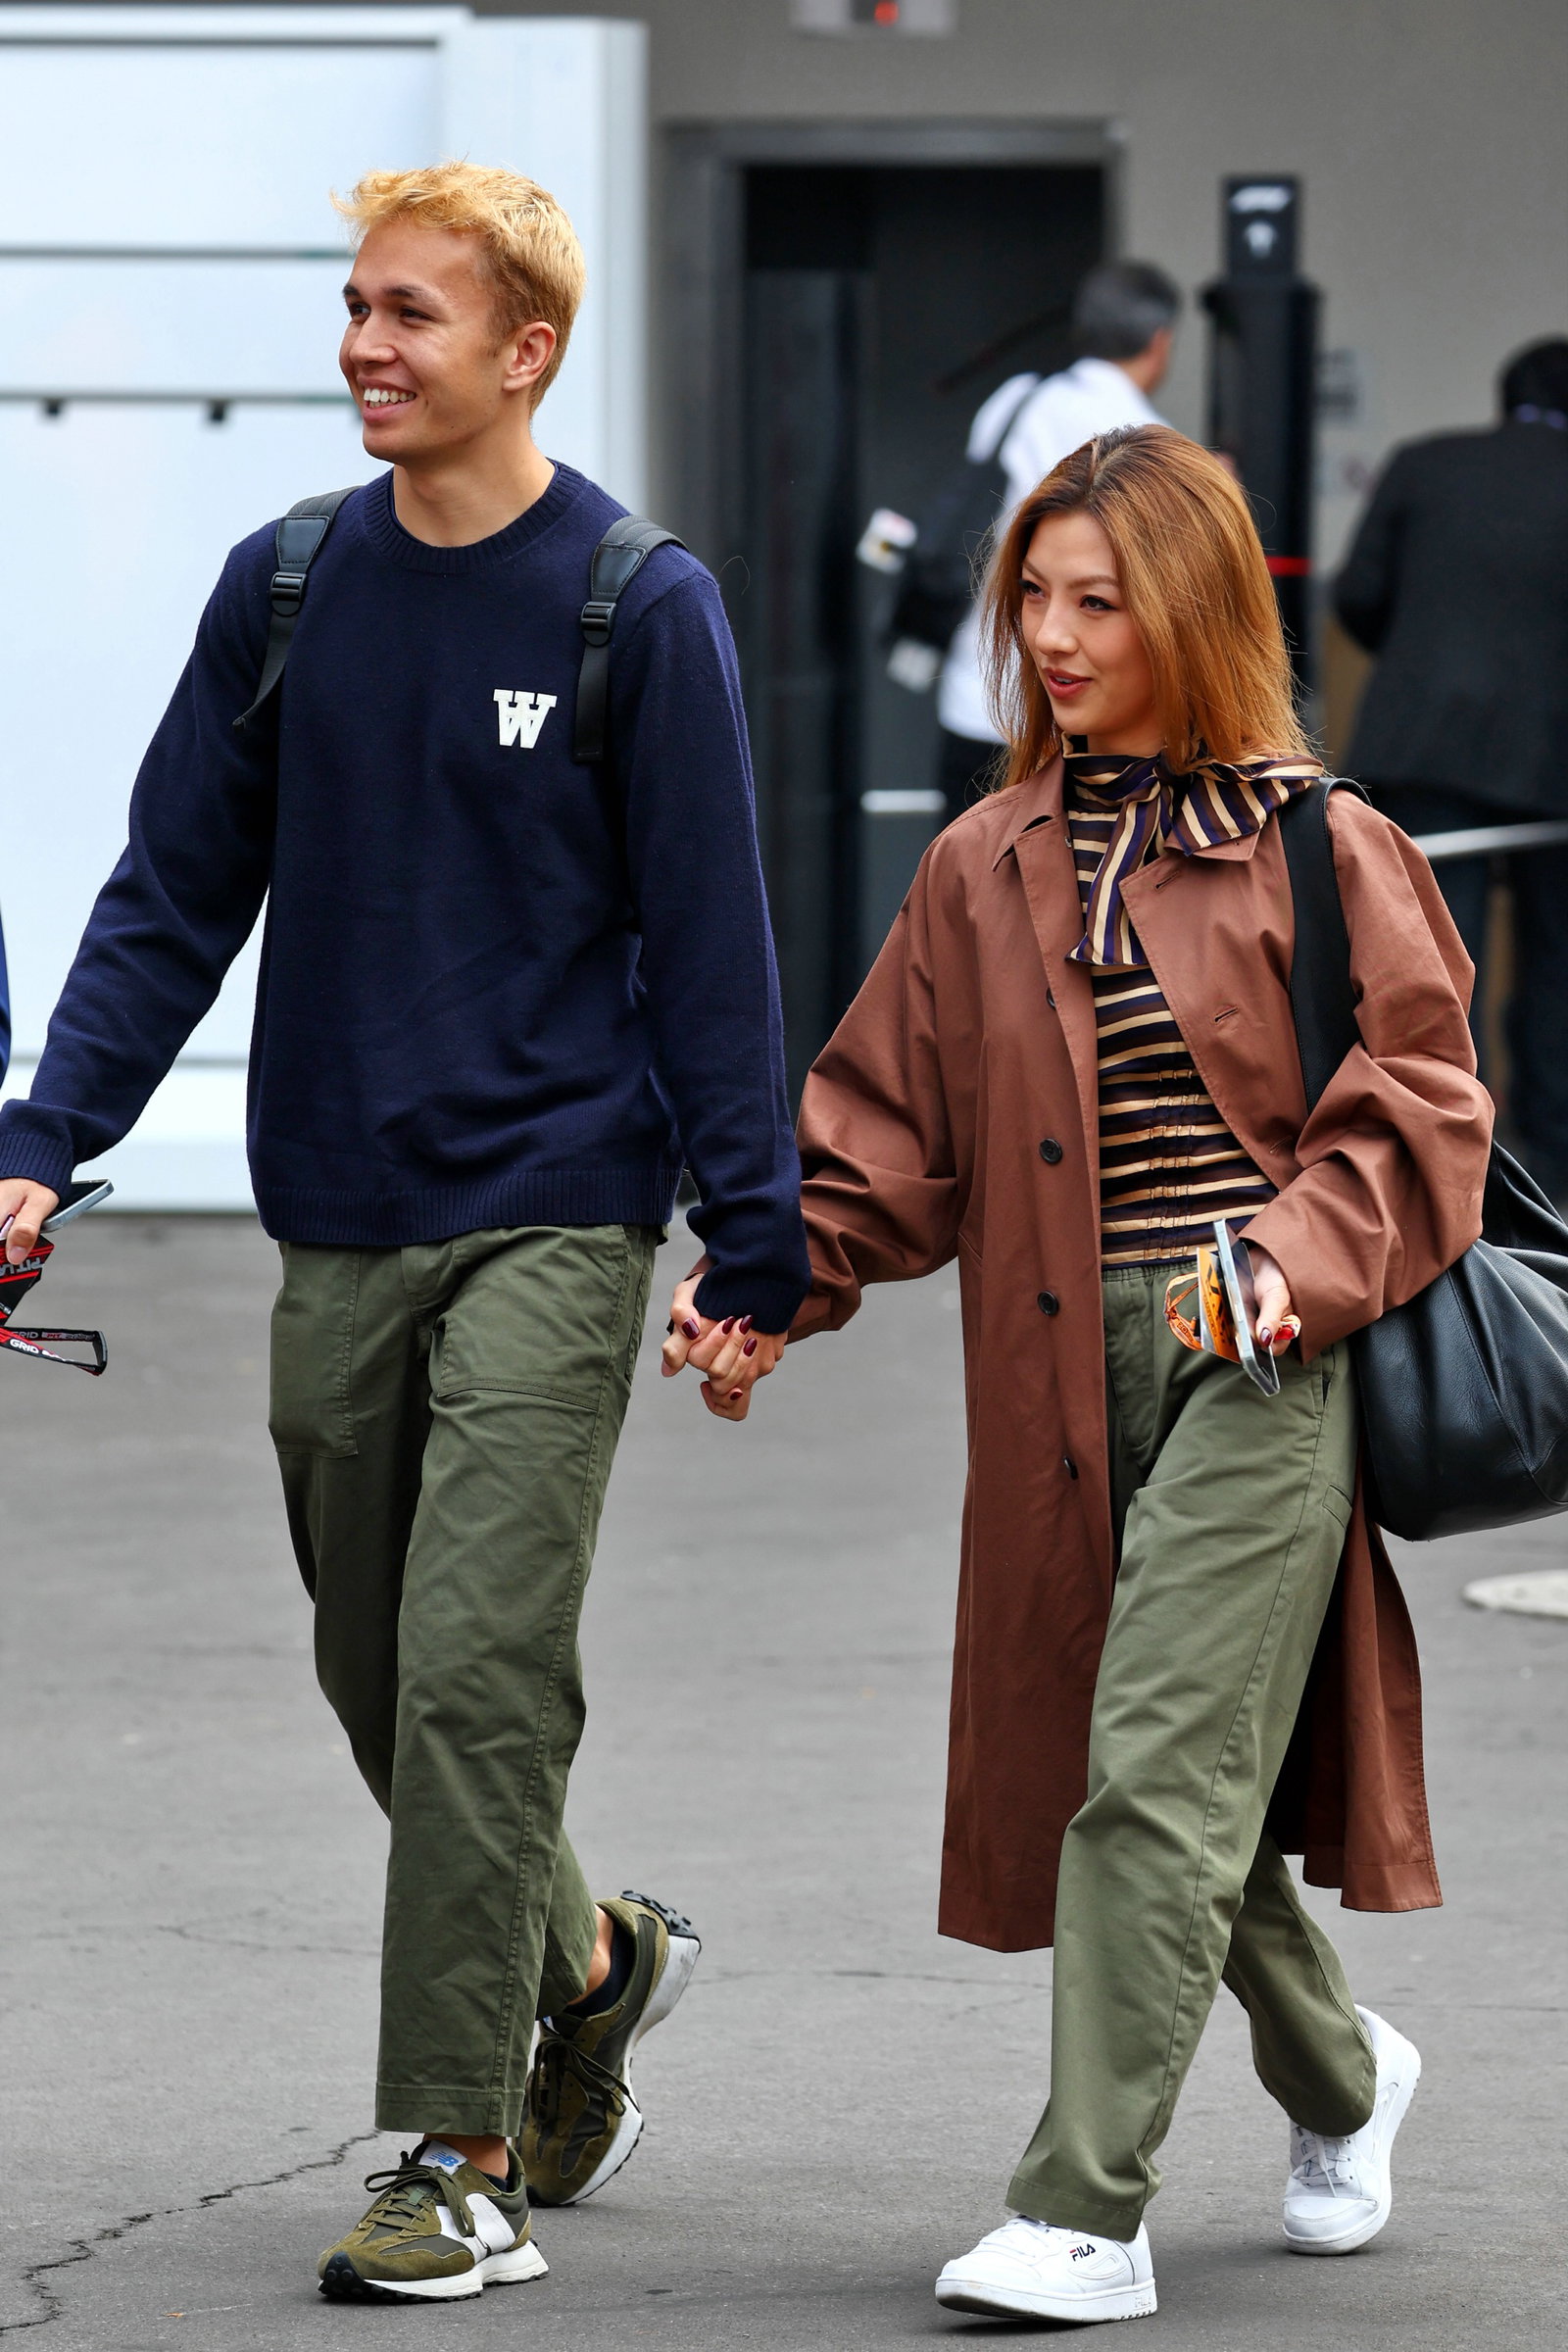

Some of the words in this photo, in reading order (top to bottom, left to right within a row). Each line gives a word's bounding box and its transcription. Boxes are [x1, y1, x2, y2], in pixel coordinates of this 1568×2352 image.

[493, 689, 558, 749] W
[17, 1256, 44, 1273] PIT
[10, 1339, 39, 1354] GRID
[1069, 2243, 1096, 2262] FILA
